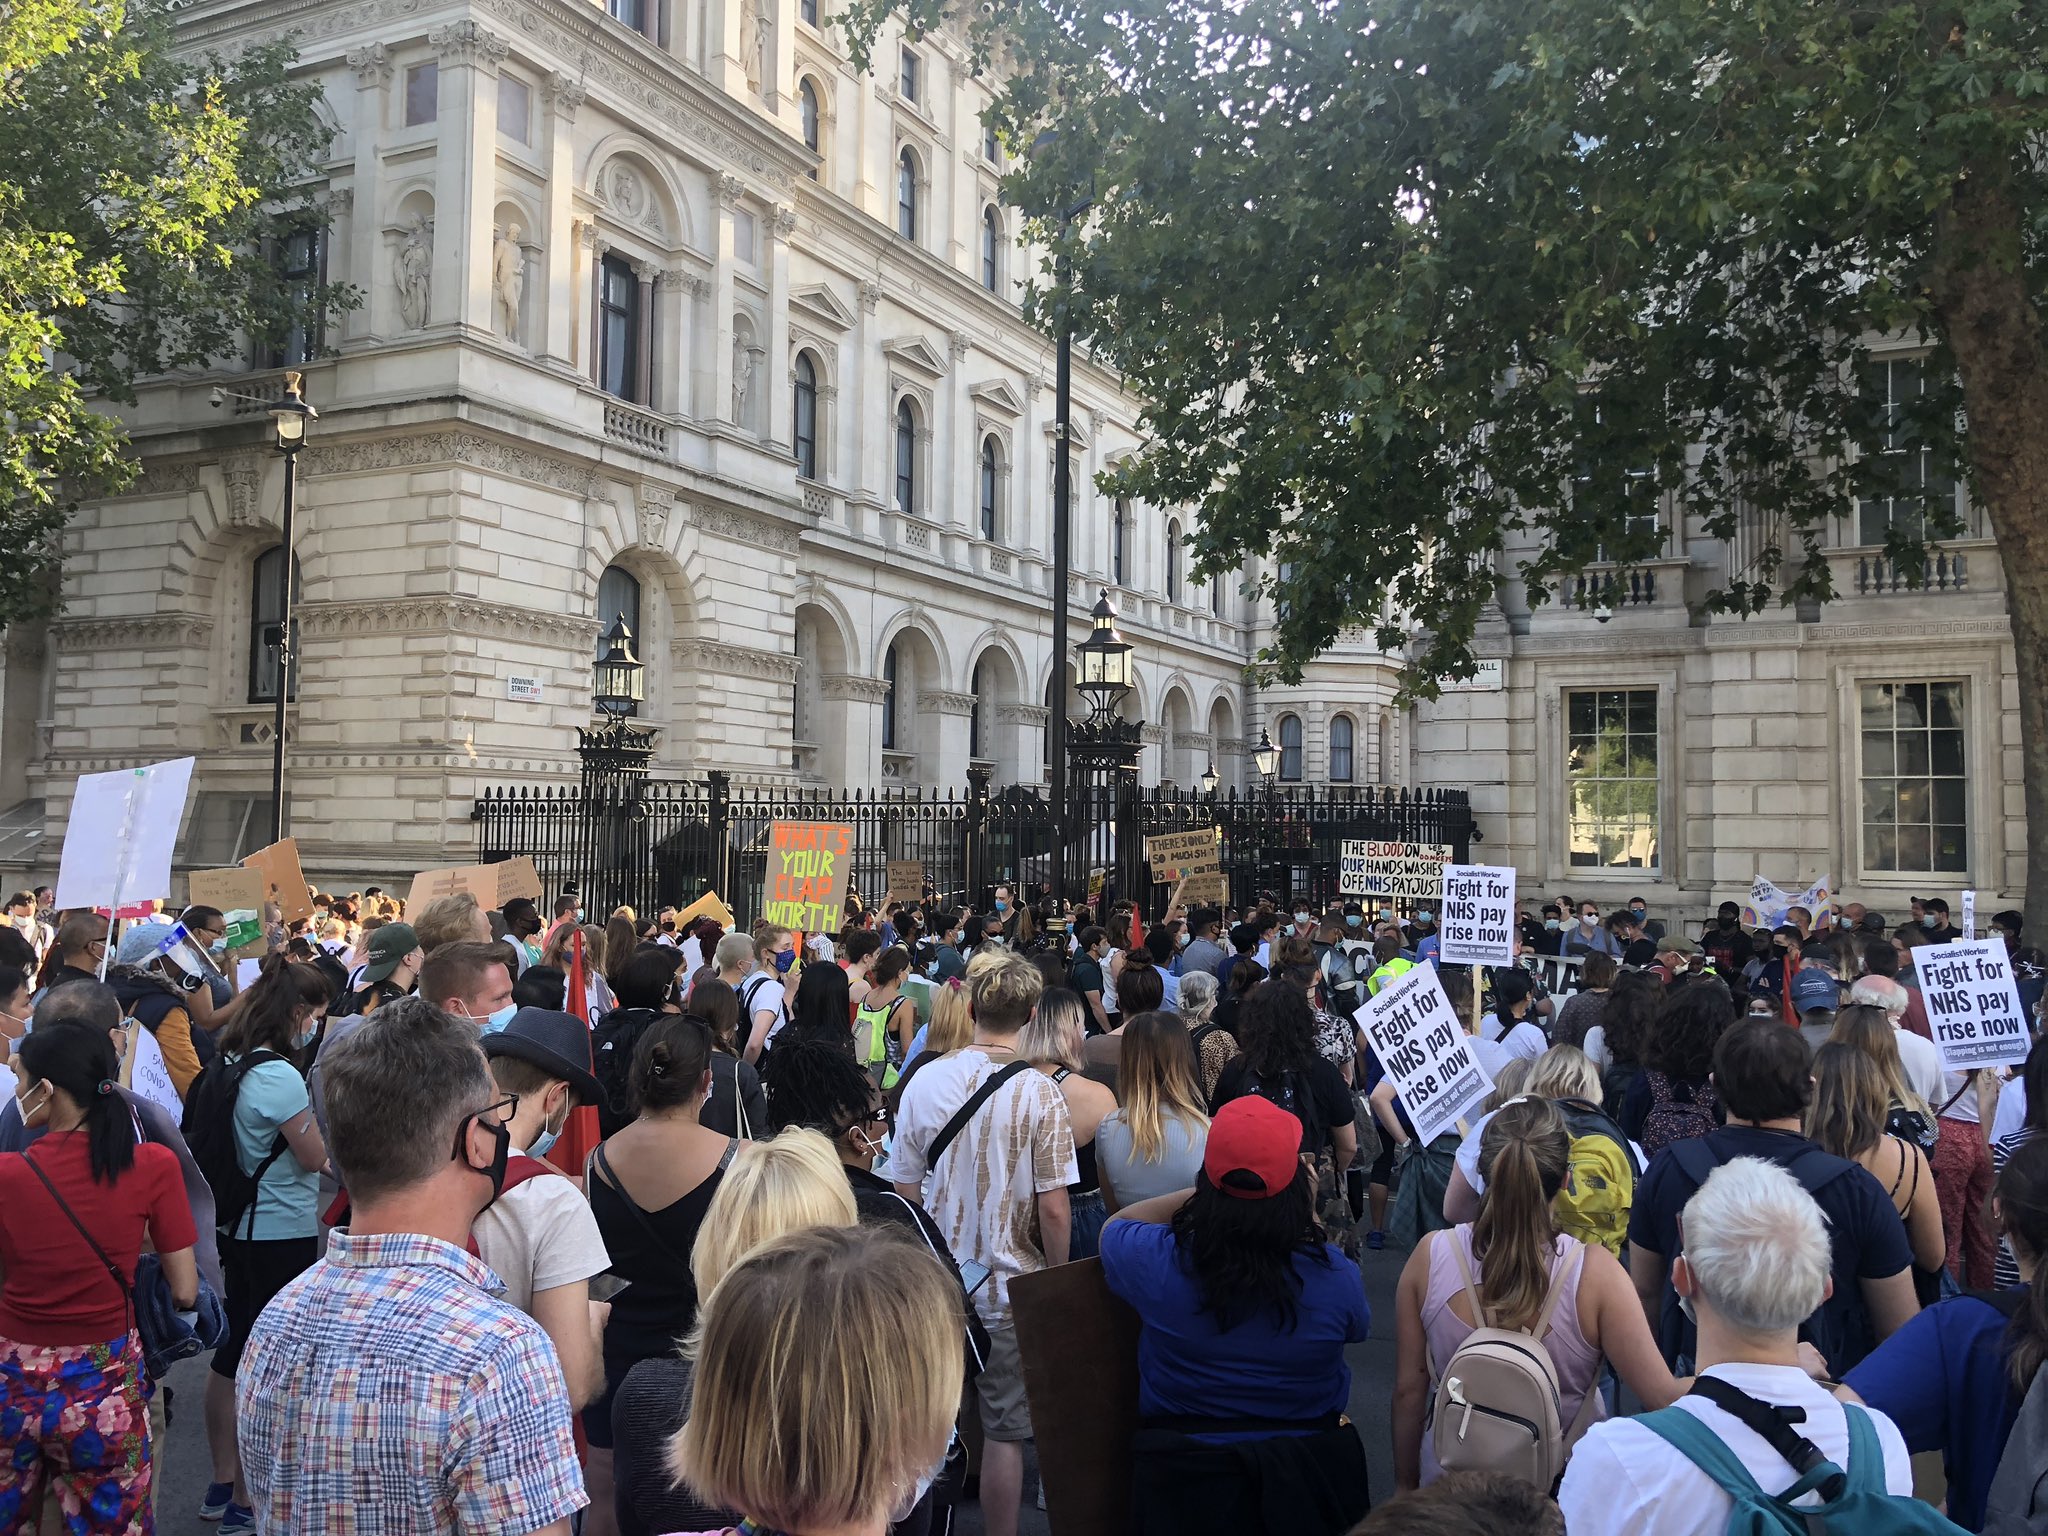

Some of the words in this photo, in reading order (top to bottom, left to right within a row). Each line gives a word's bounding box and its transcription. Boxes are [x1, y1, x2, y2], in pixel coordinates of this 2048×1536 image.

[1479, 663, 1498, 671] ALL
[511, 677, 535, 686] DOWNING
[511, 685, 529, 693] STREET
[1152, 853, 1166, 865] SO
[1343, 840, 1366, 856] THE
[1367, 841, 1404, 858] BLOOD
[1404, 844, 1421, 858] ON
[780, 849, 835, 878] YOUR
[1152, 870, 1166, 881] US
[1341, 857, 1366, 873] OUR
[1366, 859, 1404, 876] HANDS
[1404, 860, 1443, 877] WASHES
[775, 873, 833, 905] CLAP
[1365, 875, 1392, 893] NHS
[1392, 876, 1414, 895] PAY
[1446, 878, 1482, 901] Fight
[1487, 879, 1510, 898] for
[765, 899, 839, 932] WORTH
[1446, 901, 1476, 920] NHS
[1480, 907, 1507, 926] pay
[1445, 922, 1473, 941] rise
[1478, 927, 1509, 943] now
[1921, 960, 1973, 990] Fight
[1975, 958, 2004, 981] for
[1929, 990, 1972, 1016] NHS
[1976, 991, 2010, 1016] pay
[1369, 1003, 1418, 1053] Fight
[1412, 986, 1440, 1019] for
[1937, 1018, 1977, 1042] rise
[1981, 1016, 2020, 1037] now
[1386, 1038, 1427, 1084] NHS
[1425, 1019, 1456, 1061] pay
[1978, 1045, 1985, 1054] is
[1986, 1044, 1999, 1053] not
[140, 1065, 166, 1090] COVID
[1404, 1074, 1440, 1112] rise
[1438, 1046, 1471, 1085] now
[1418, 1102, 1446, 1127] Clapping
[1442, 1094, 1452, 1107] is
[1449, 1087, 1462, 1103] not
[1458, 1070, 1480, 1094] enough
